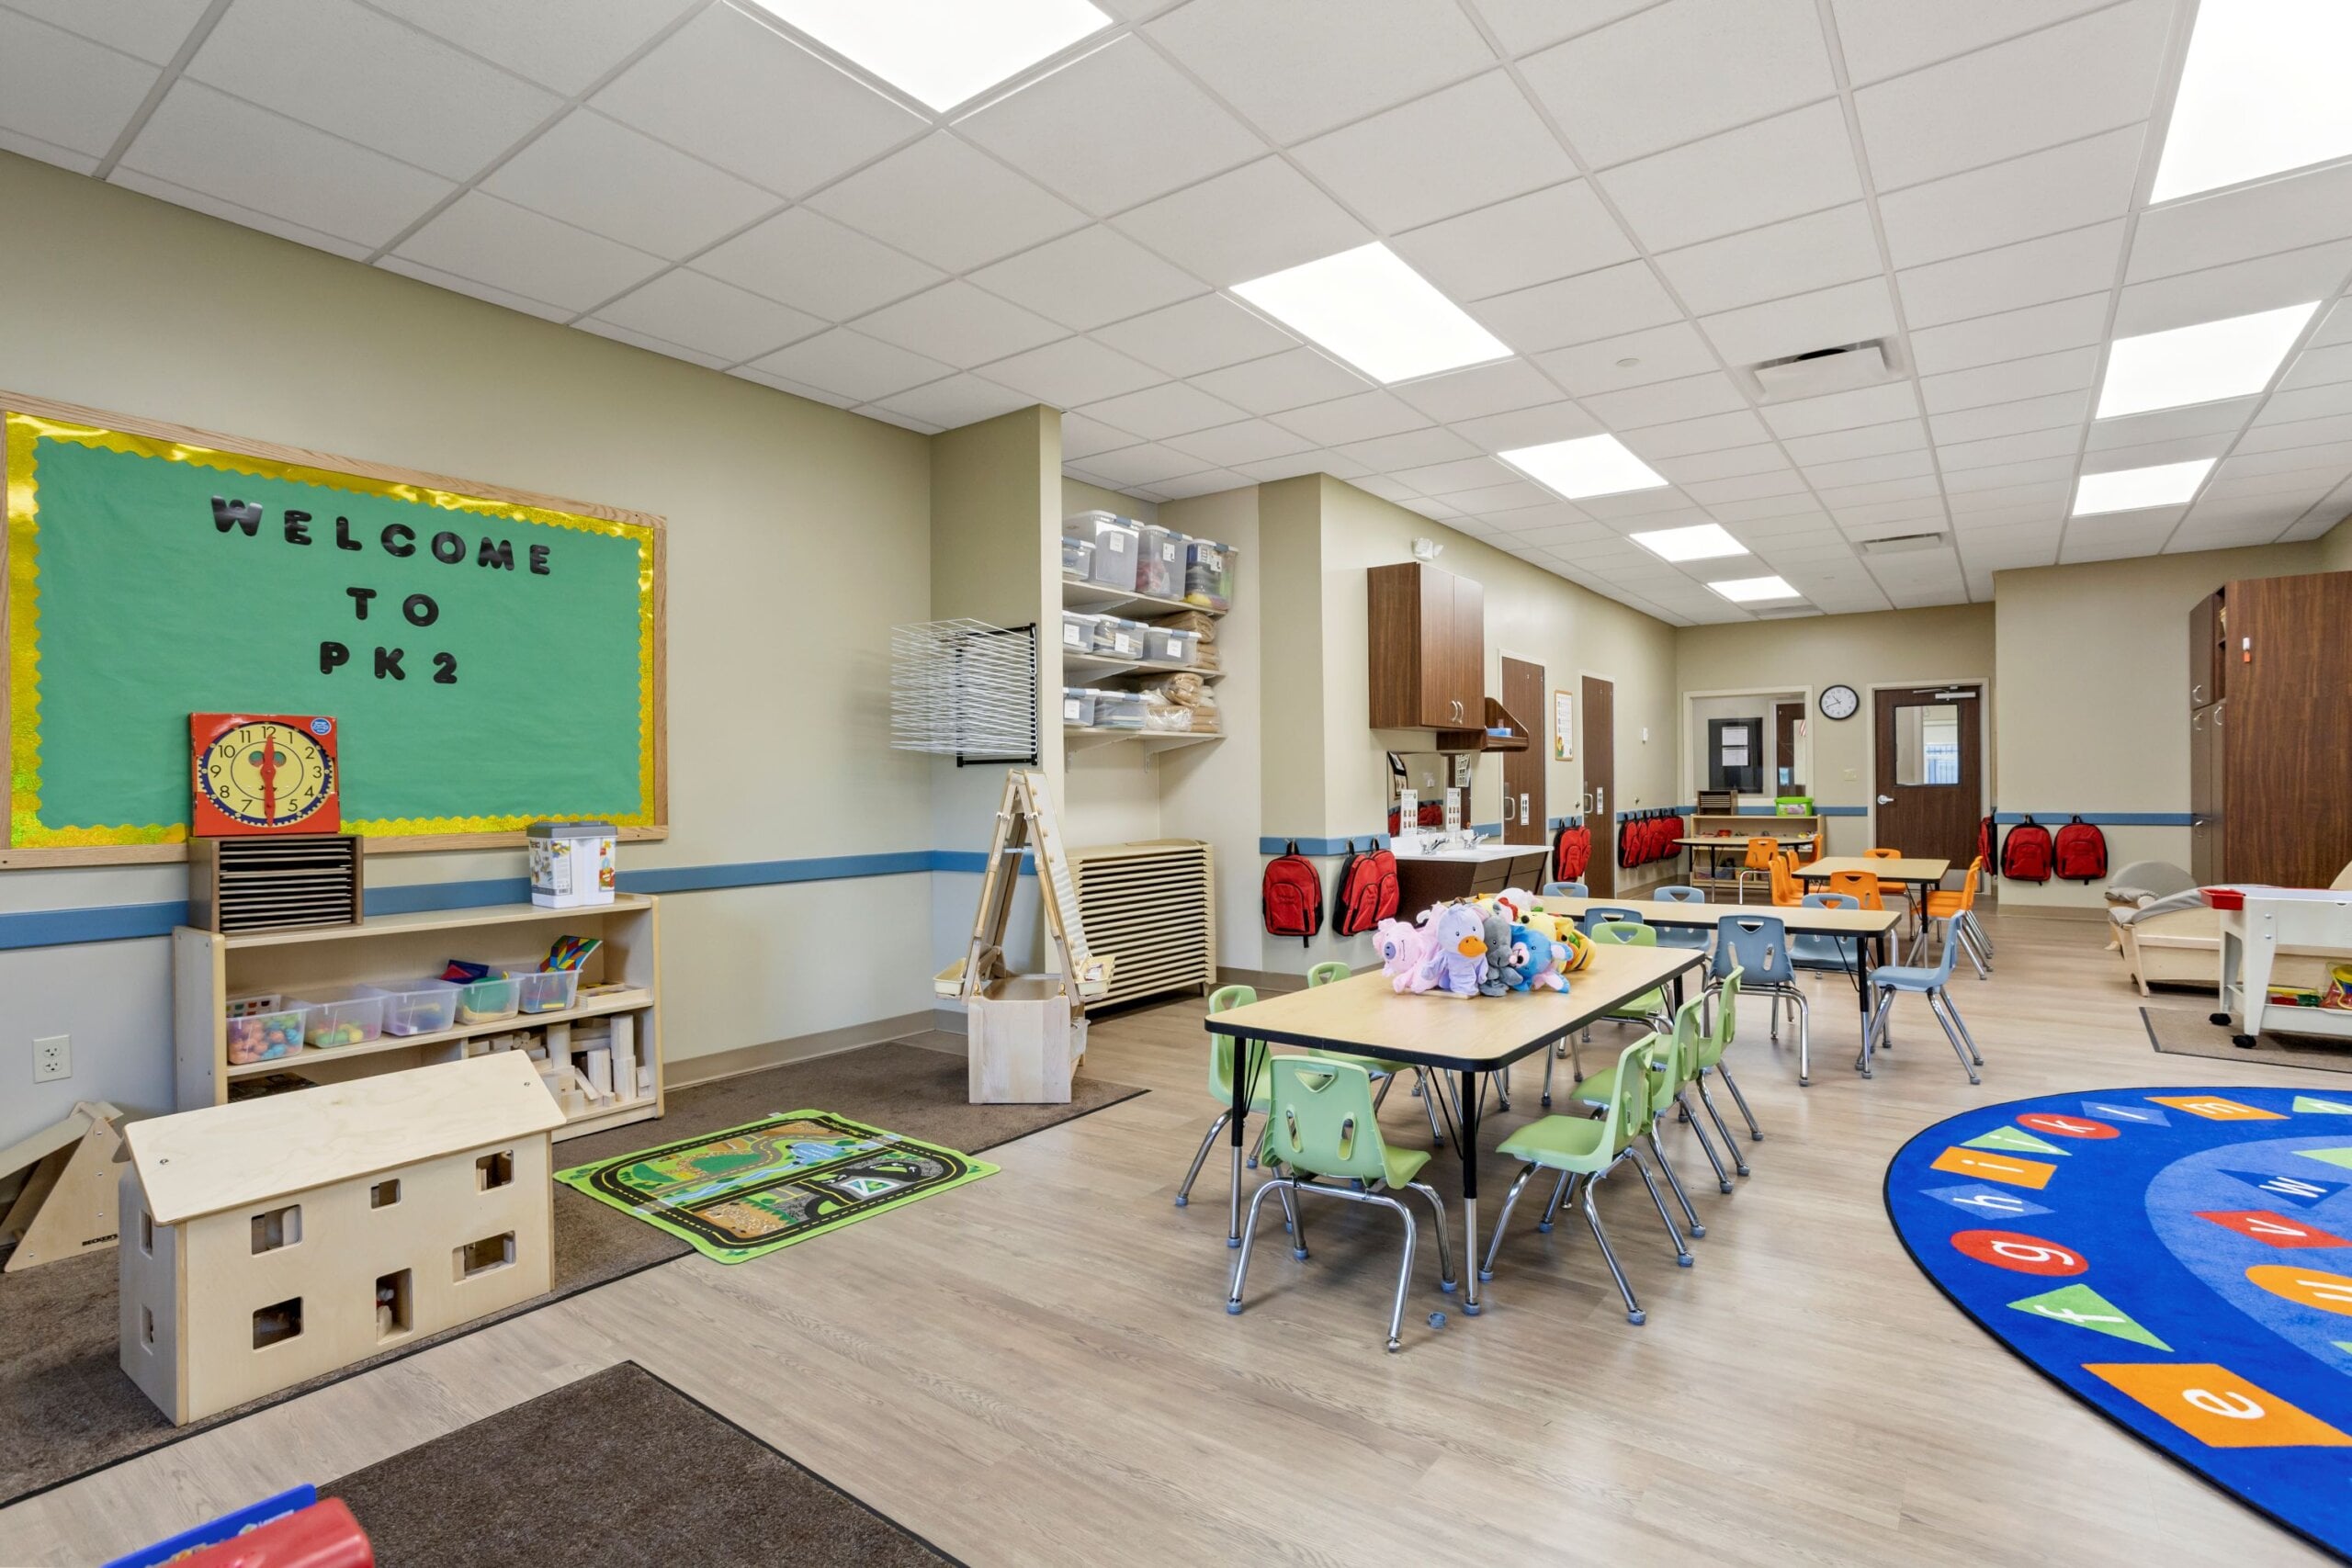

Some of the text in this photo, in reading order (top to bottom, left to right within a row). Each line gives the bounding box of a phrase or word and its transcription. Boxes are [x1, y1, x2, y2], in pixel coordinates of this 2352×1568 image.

[210, 496, 551, 576] WELCOME
[346, 587, 440, 627] TO
[239, 729, 251, 743] 11
[261, 726, 277, 739] 12
[288, 731, 293, 744] 1
[218, 744, 236, 759] 10
[305, 746, 315, 760] 2
[209, 764, 221, 778] 9
[312, 765, 322, 779] 3
[220, 784, 230, 798] 8
[304, 785, 314, 798] 4
[242, 799, 253, 812] 7
[288, 798, 299, 812] 5
[2030, 1119, 2097, 1134] k
[1988, 1134, 2060, 1154] j
[1962, 1159, 2025, 1173] i
[2258, 1176, 2328, 1198] w
[1952, 1194, 2024, 1213] h
[2245, 1217, 2308, 1236] v
[1991, 1240, 2075, 1267] g
[2033, 1304, 2127, 1325] f
[2182, 1388, 2266, 1420] e
